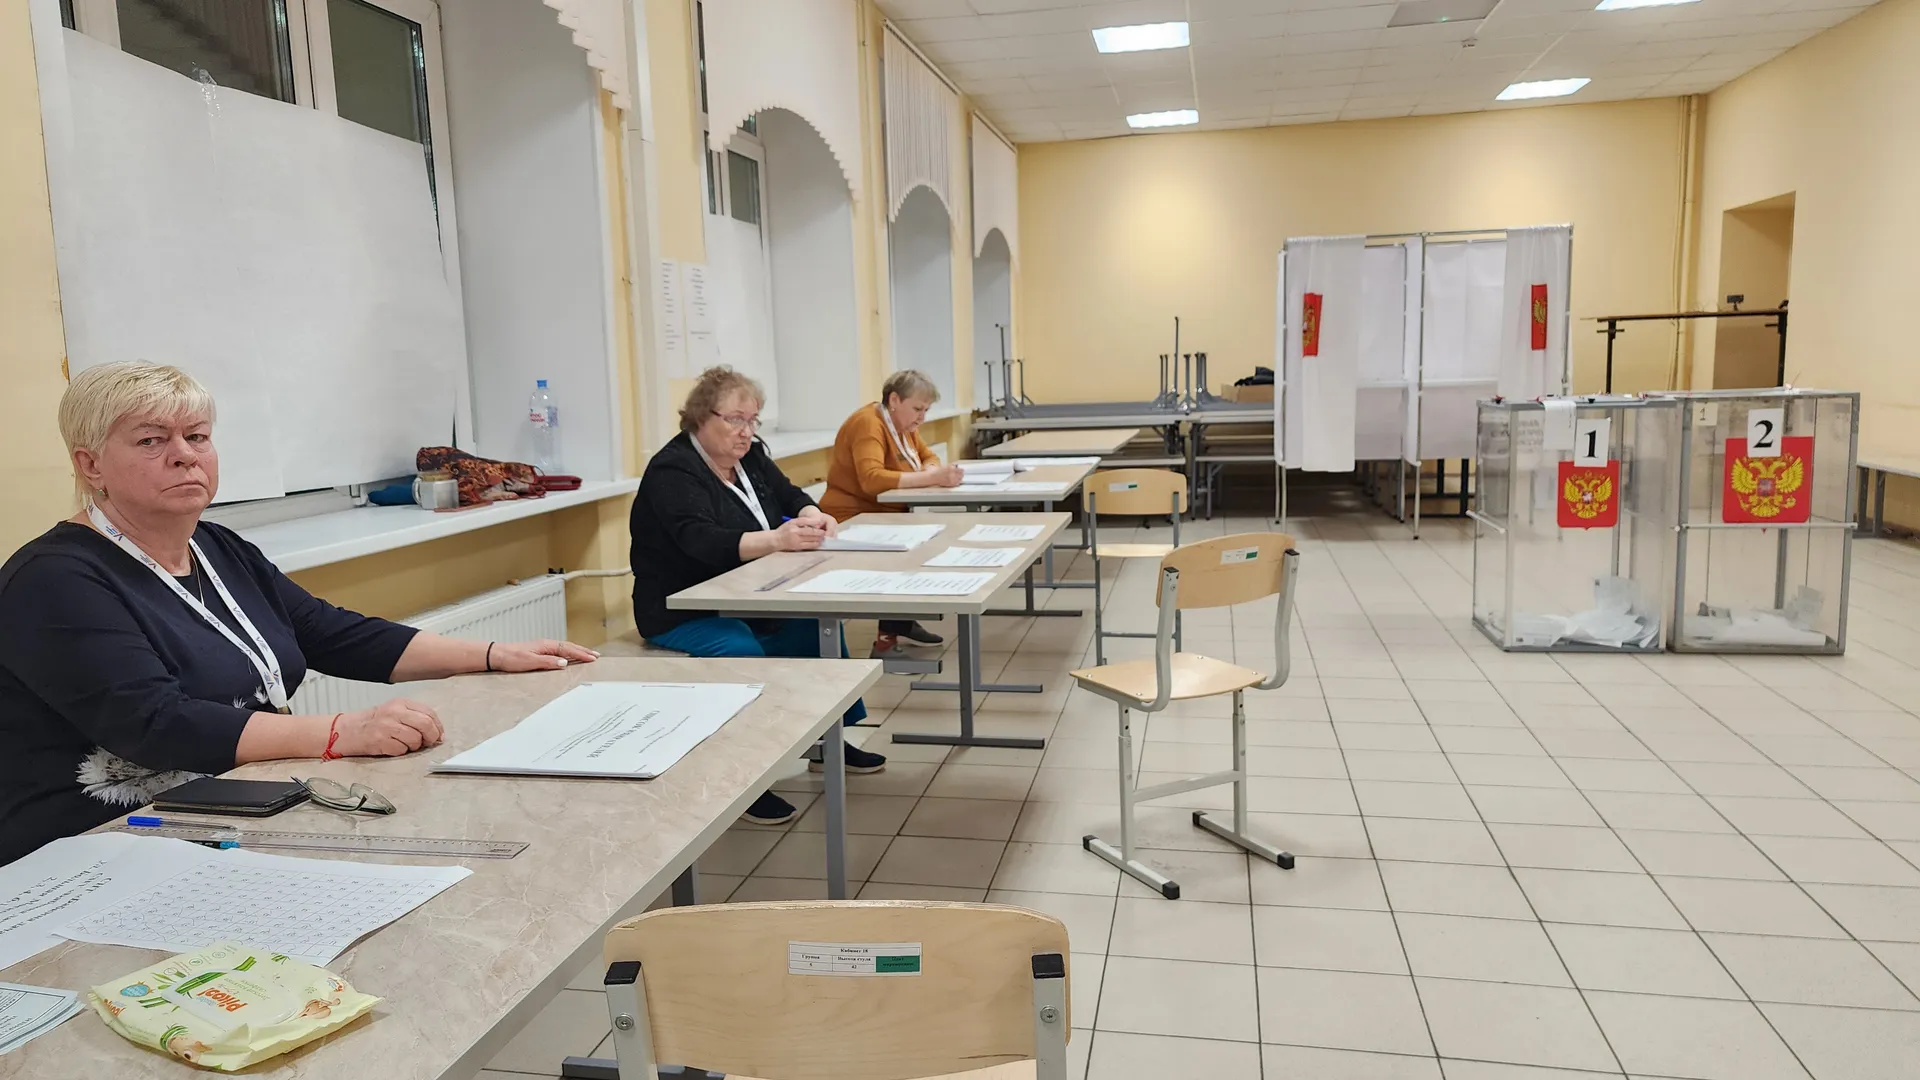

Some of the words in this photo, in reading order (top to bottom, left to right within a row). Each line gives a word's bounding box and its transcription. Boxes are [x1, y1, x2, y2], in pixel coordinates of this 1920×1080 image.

[1584, 430, 1599, 458] 1
[1753, 420, 1774, 449] 2
[86, 877, 112, 893] СНТ
